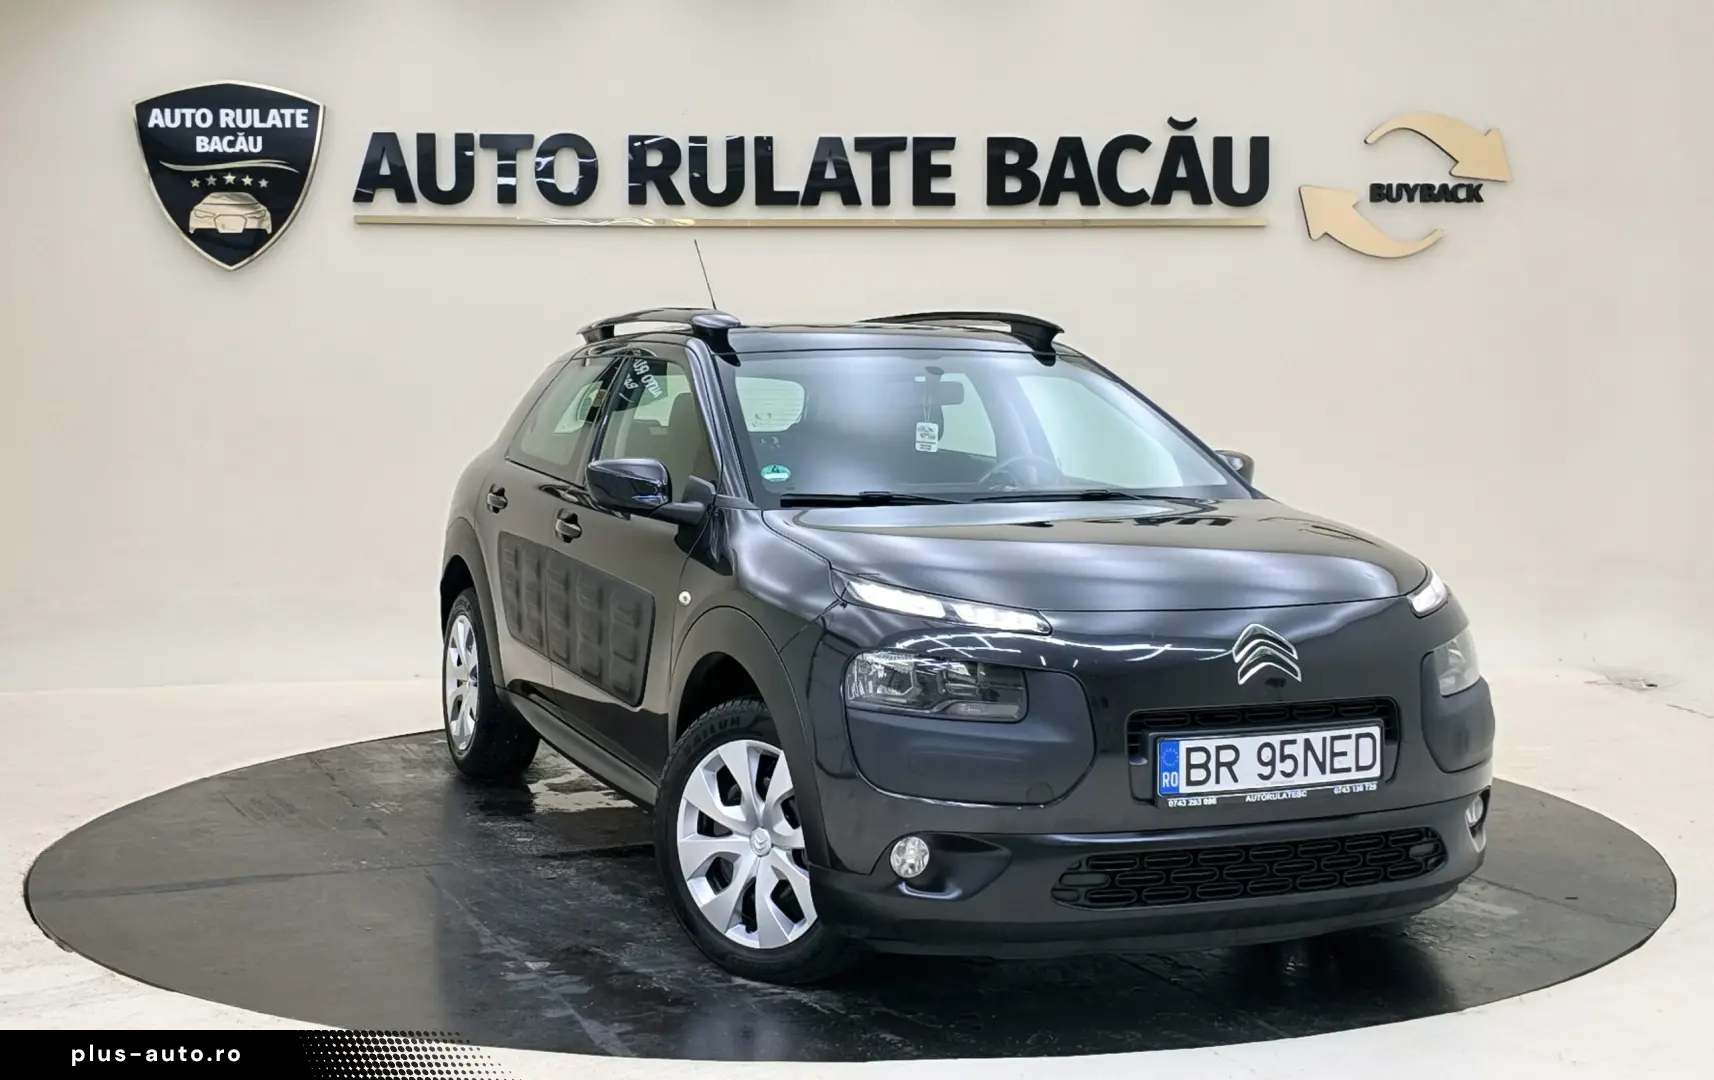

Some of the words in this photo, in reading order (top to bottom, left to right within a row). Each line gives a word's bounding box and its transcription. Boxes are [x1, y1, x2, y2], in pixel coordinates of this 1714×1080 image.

[148, 108, 213, 128] AUTO
[219, 108, 309, 128] RULATE
[196, 131, 263, 153] BACĂU
[353, 132, 599, 206] AUTO
[628, 135, 956, 207] RULATE
[986, 116, 1270, 207] BACĂU
[1369, 183, 1484, 203] BUYBACK
[1185, 744, 1240, 787] BR
[1256, 732, 1378, 781] 95NED
[1162, 771, 1178, 788] RO
